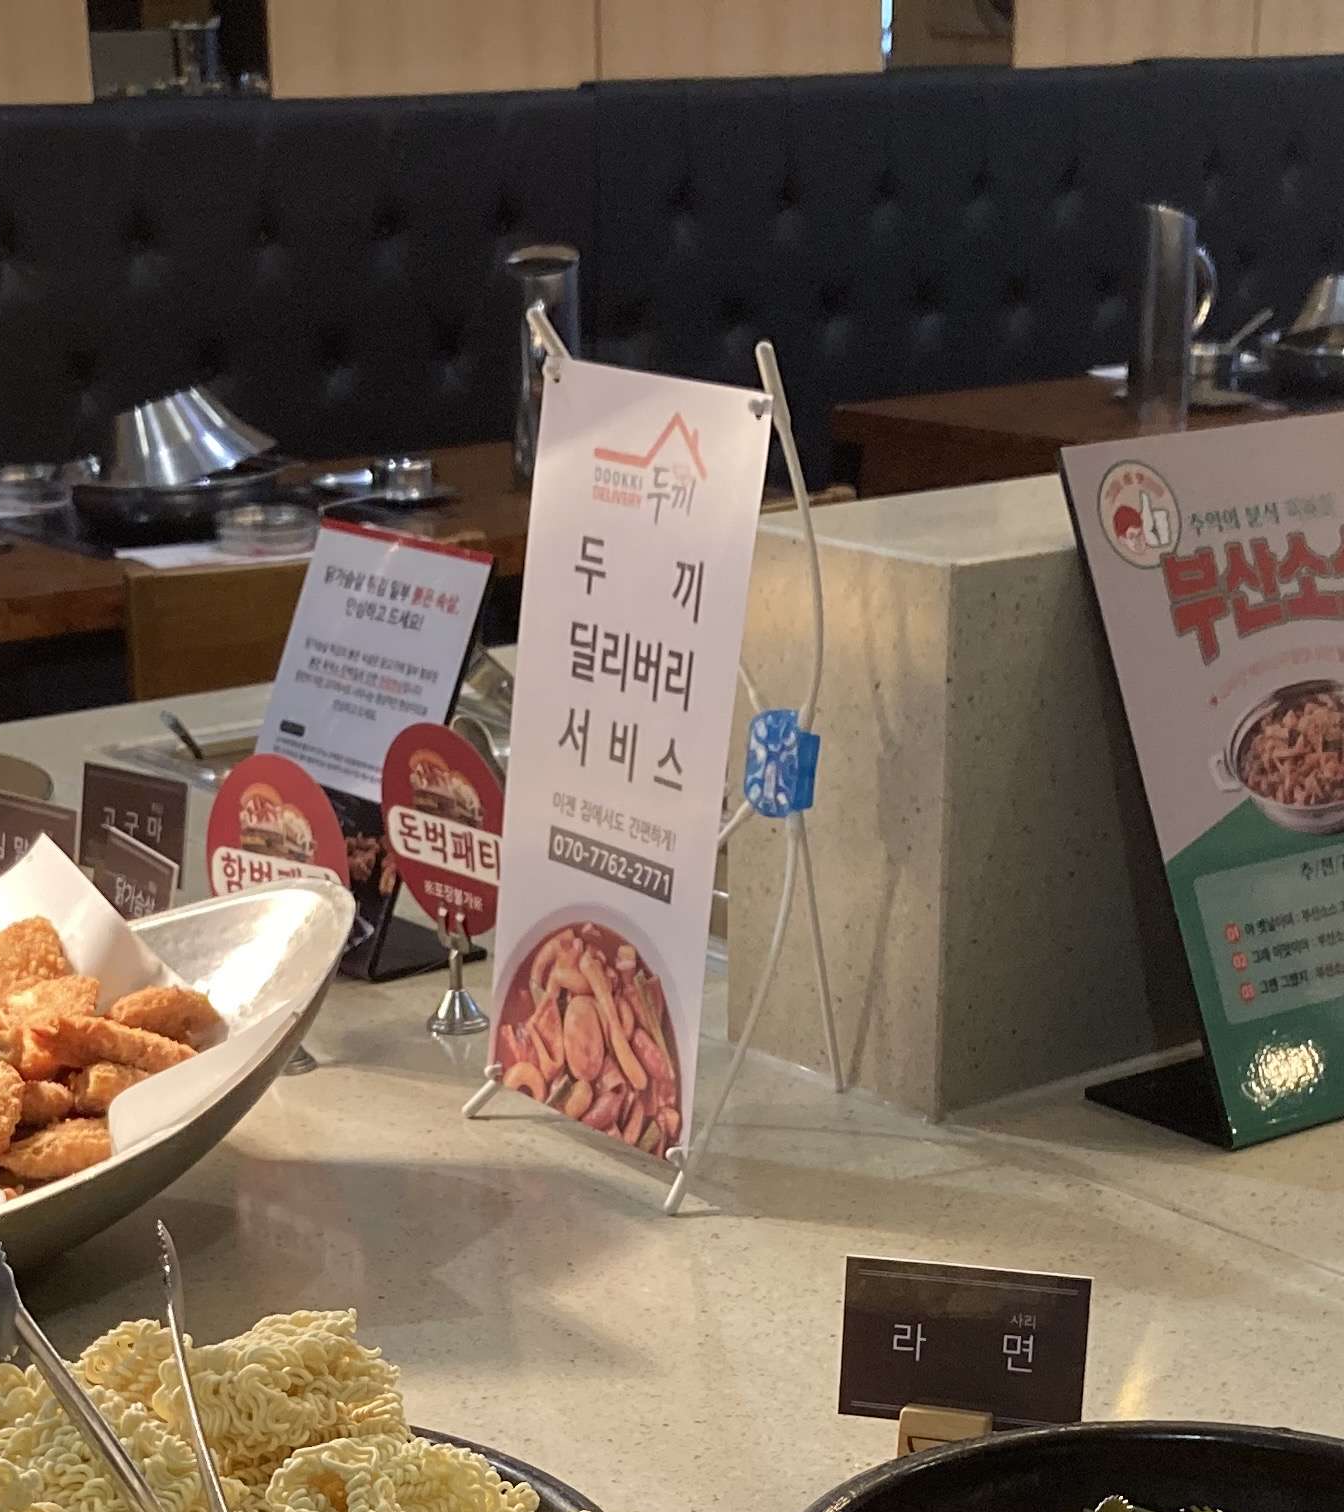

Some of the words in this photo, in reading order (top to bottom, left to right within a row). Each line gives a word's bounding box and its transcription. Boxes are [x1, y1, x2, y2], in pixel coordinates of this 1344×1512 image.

[594, 466, 642, 490] DOOKKI
[648, 466, 696, 526] 두끼
[570, 621, 694, 712] 딜리버리
[558, 708, 684, 791] 서비스
[552, 792, 577, 818] 이젠
[580, 799, 625, 833] 집에서도
[399, 812, 500, 881] 돈벅패티
[554, 834, 671, 896] 070-7762-2771
[1009, 1312, 1037, 1331] 사리
